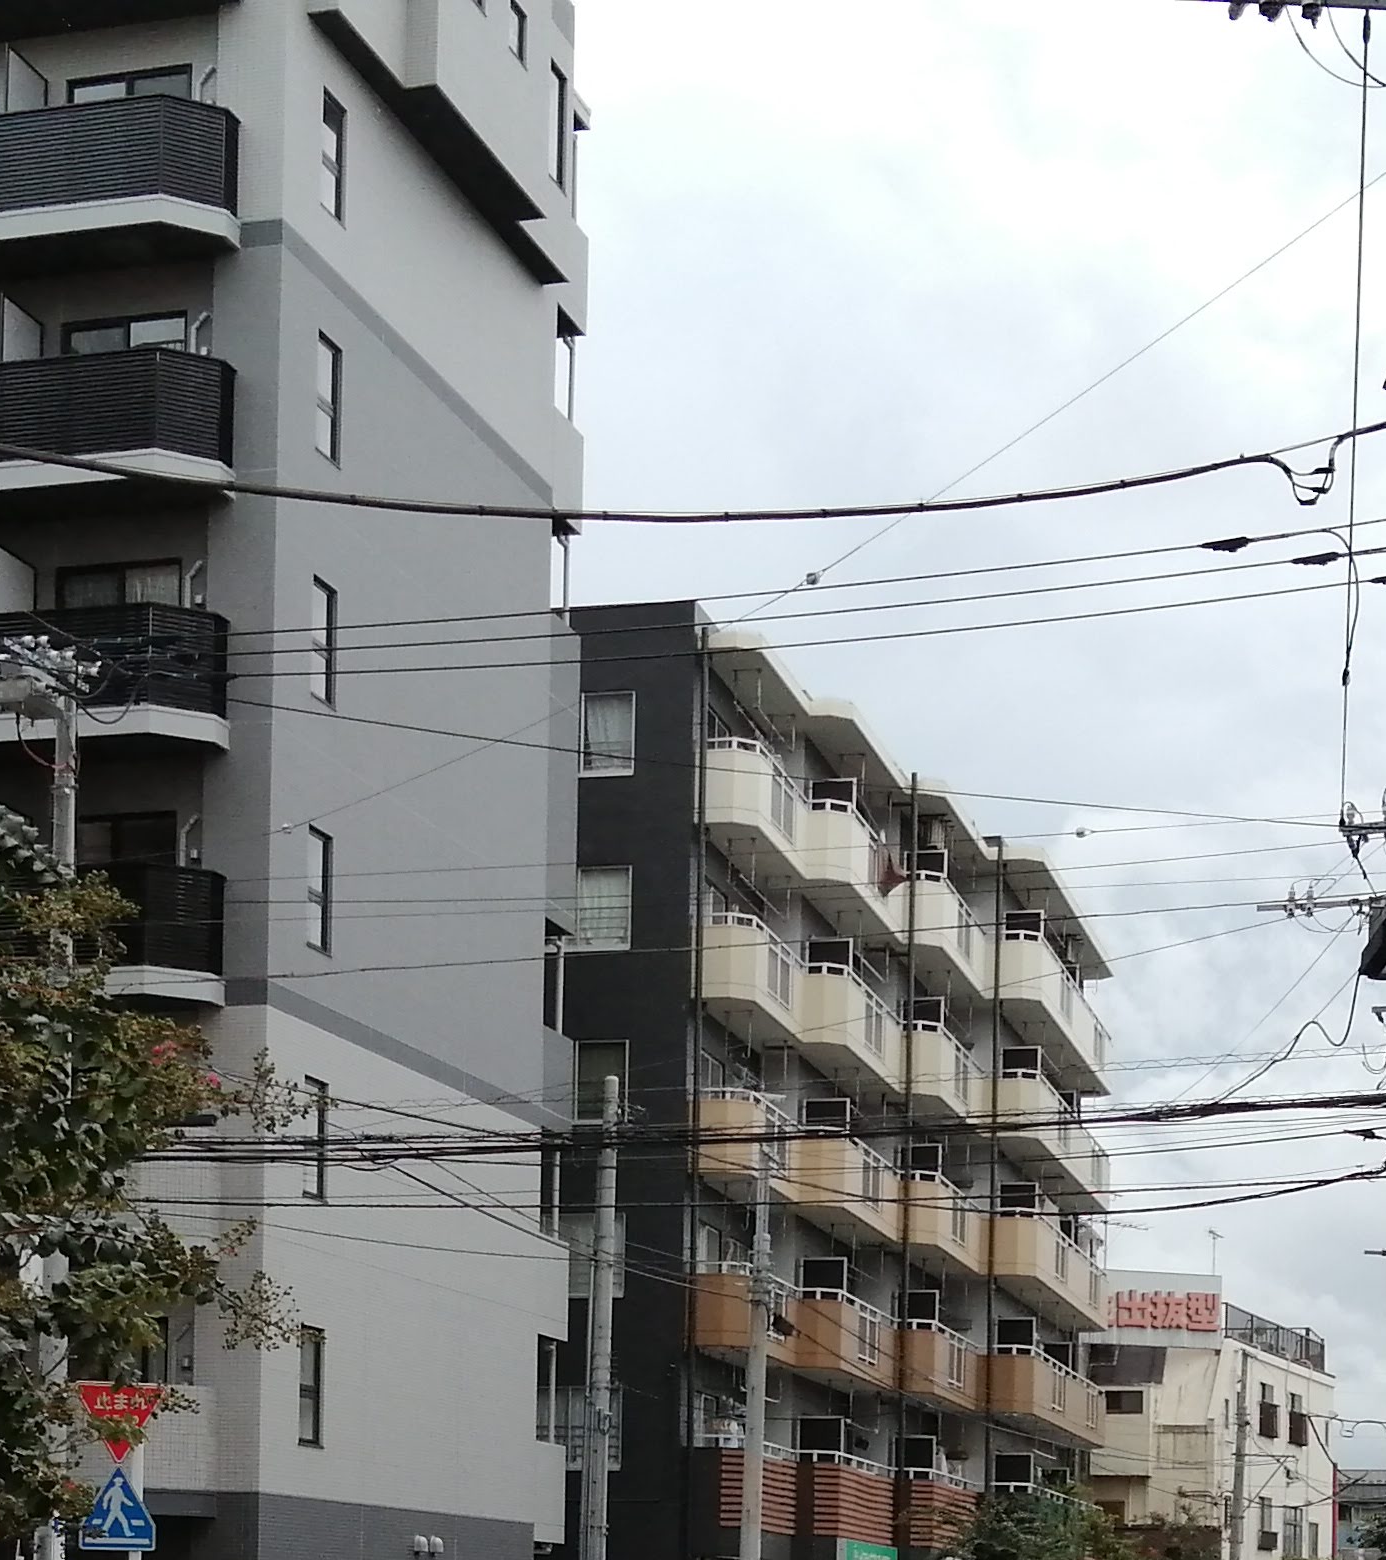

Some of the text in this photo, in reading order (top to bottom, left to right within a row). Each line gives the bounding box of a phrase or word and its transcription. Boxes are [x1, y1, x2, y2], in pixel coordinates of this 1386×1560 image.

[1108, 1289, 1221, 1332] 出抜型
[94, 1391, 147, 1411] 止まれ
